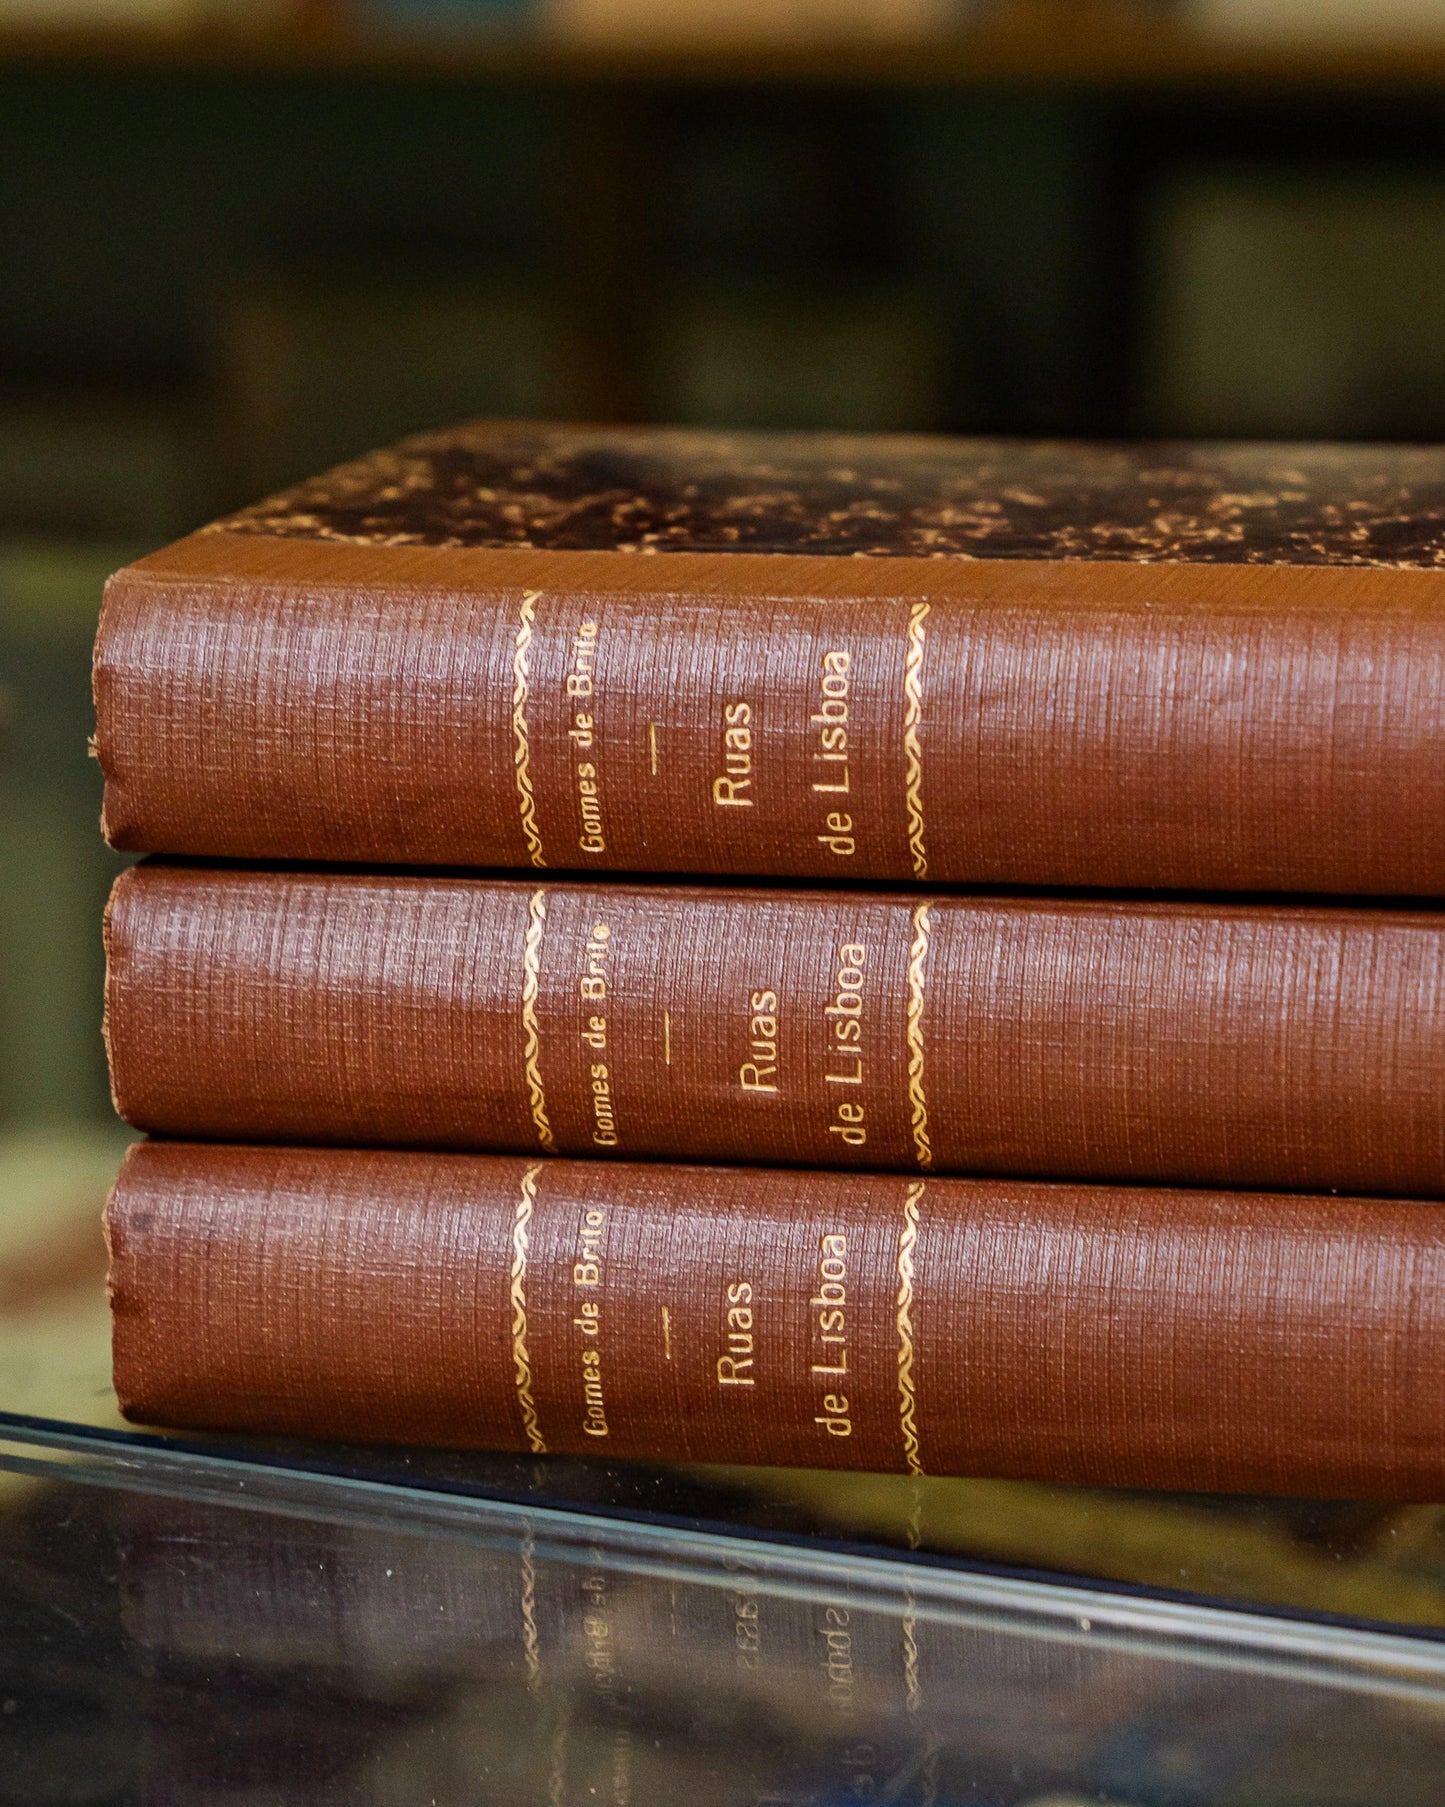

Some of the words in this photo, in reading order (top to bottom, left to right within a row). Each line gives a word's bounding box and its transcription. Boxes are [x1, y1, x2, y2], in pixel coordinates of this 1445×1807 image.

[567, 622, 598, 696] Brito
[568, 713, 594, 747] de
[713, 703, 753, 806] Ruas
[810, 651, 851, 792] Lisboa
[579, 762, 606, 852] Gomes
[817, 812, 855, 855] de
[580, 925, 610, 1000] Brito
[581, 1016, 607, 1048] de
[739, 990, 779, 1092] Ruas
[825, 943, 866, 1084] Lisboa
[593, 1064, 618, 1146] Gomes
[829, 1103, 866, 1145] de
[573, 1211, 603, 1286] Brito
[573, 1303, 599, 1335] de
[717, 1282, 755, 1385] Ruas
[810, 1234, 847, 1373] Lisboa
[582, 1351, 609, 1436] Gomes
[814, 1394, 852, 1436] de
